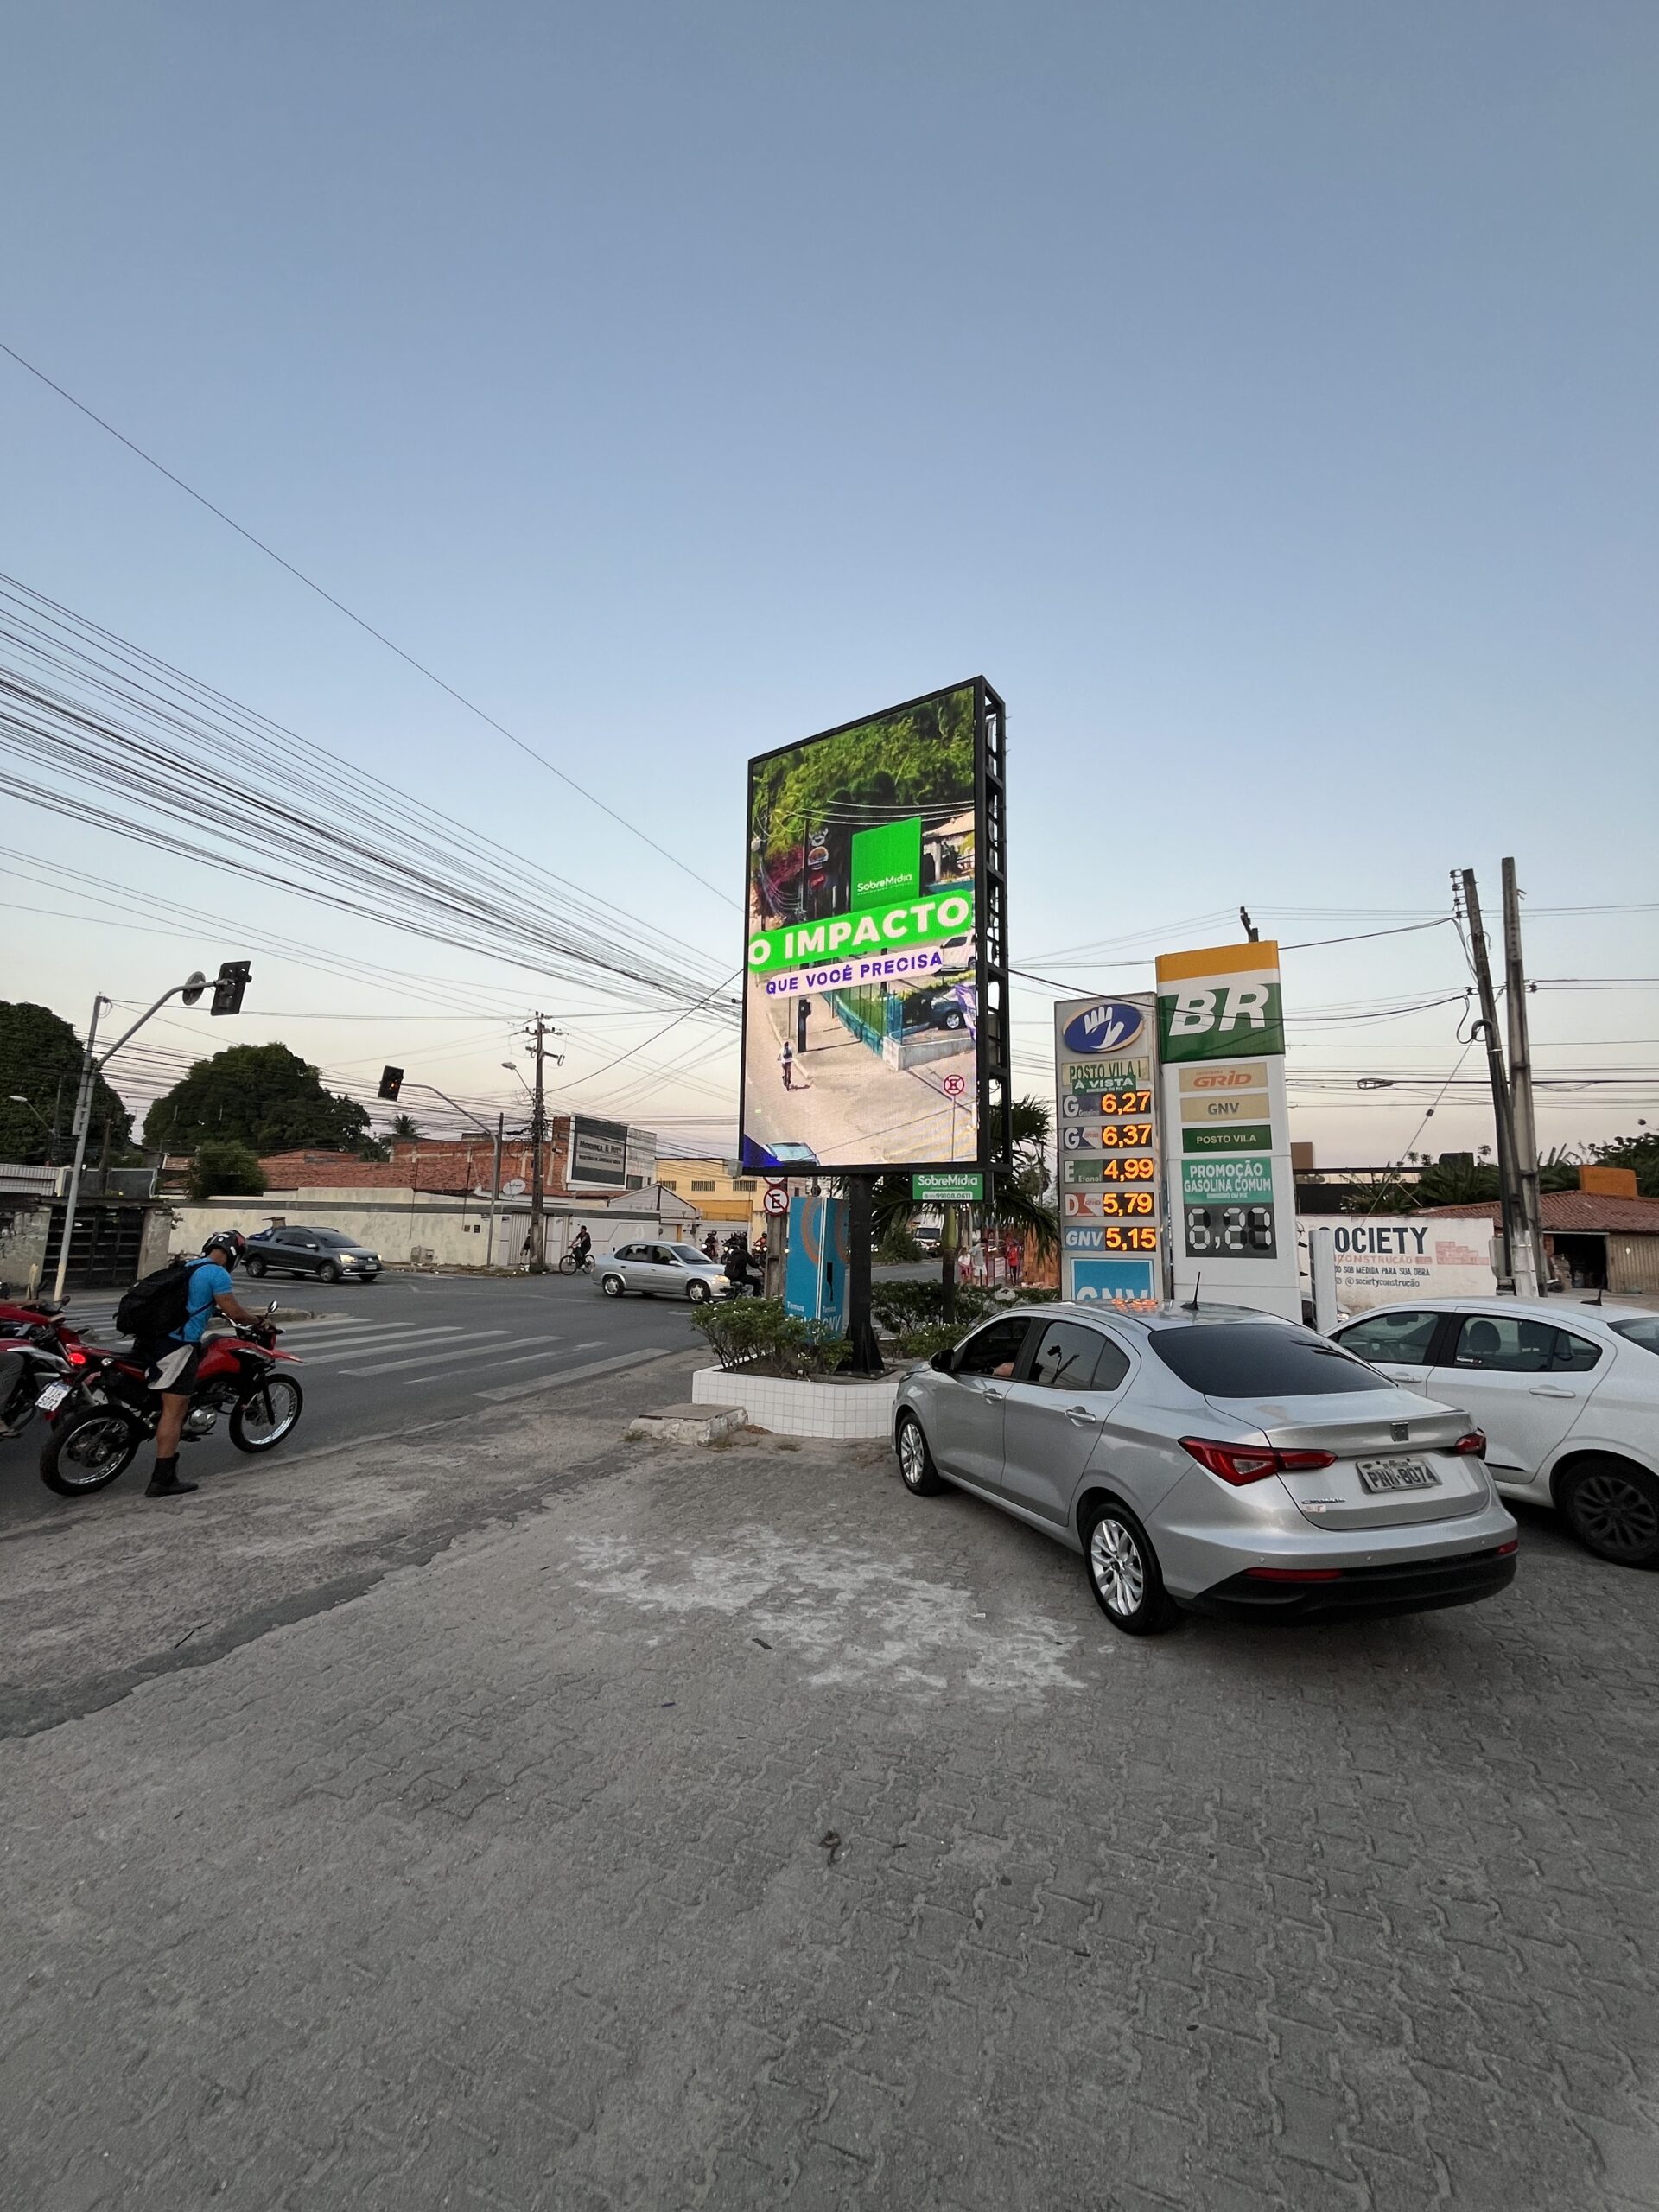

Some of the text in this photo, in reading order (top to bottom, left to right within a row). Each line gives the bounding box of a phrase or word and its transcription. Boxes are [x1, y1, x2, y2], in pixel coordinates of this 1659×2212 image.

[748, 897, 969, 965] O IMPACTO
[766, 951, 943, 995] QUE VOCÊ PRECISA
[1169, 983, 1269, 1037] BR
[1069, 1063, 1105, 1084] POSTO
[1089, 1077, 1134, 1088] VISTA
[1193, 1070, 1252, 1088] GRID
[1063, 1095, 1079, 1118] G
[1102, 1091, 1151, 1116] 6,27
[1208, 1102, 1240, 1116] GNV
[1064, 1127, 1080, 1150] G
[1103, 1124, 1152, 1148] 6,37
[1196, 1134, 1257, 1145] POSTO VILA
[1064, 1160, 1075, 1183] E
[1104, 1158, 1154, 1183] 4,99
[1189, 1160, 1263, 1179] PROMOÇÃO
[1184, 1178, 1272, 1192] GASOLINA COMUM
[1065, 1193, 1079, 1216] D
[1103, 1193, 1153, 1217] 5,79
[1065, 1227, 1156, 1251] GNV 5,15
[1319, 1226, 1428, 1254] OCIETY
[1382, 1267, 1397, 1275] PARA
[1399, 1268, 1412, 1276] SUA
